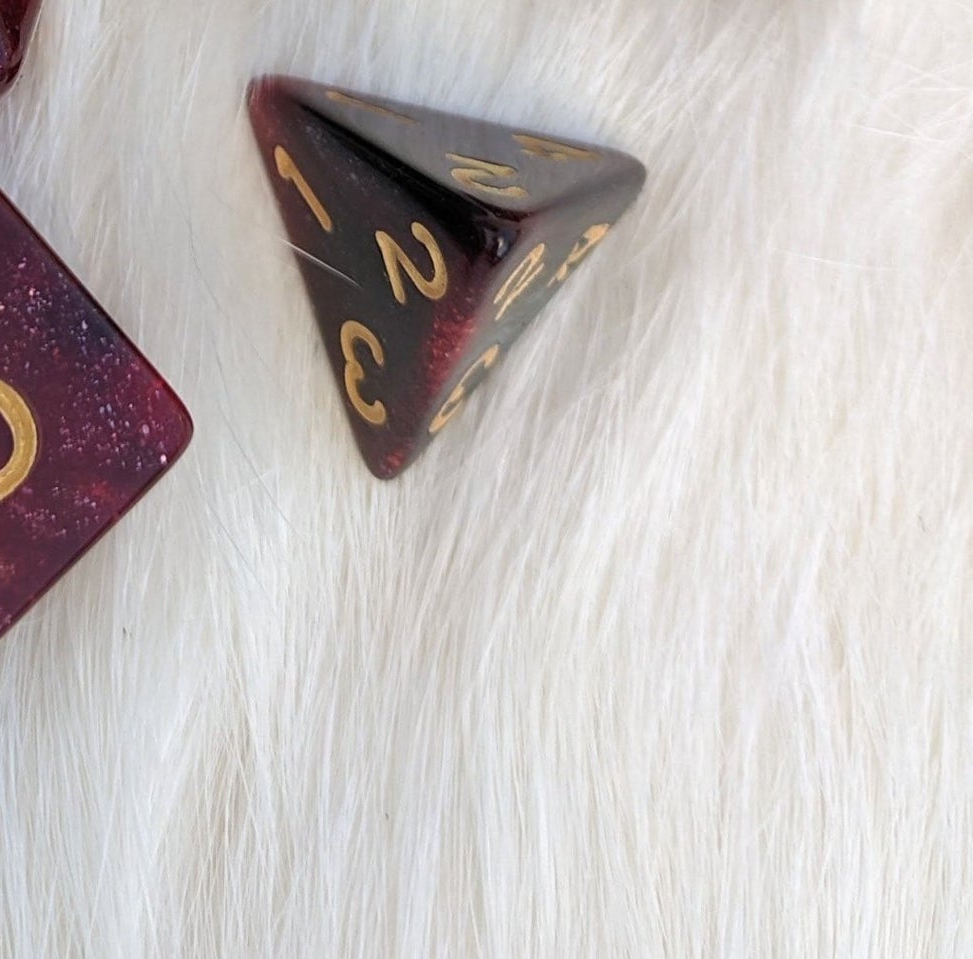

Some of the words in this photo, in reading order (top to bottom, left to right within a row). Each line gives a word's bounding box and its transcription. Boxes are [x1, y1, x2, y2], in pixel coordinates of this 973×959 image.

[273, 144, 332, 233] 1
[375, 221, 448, 305] 2
[340, 320, 387, 425] 3
